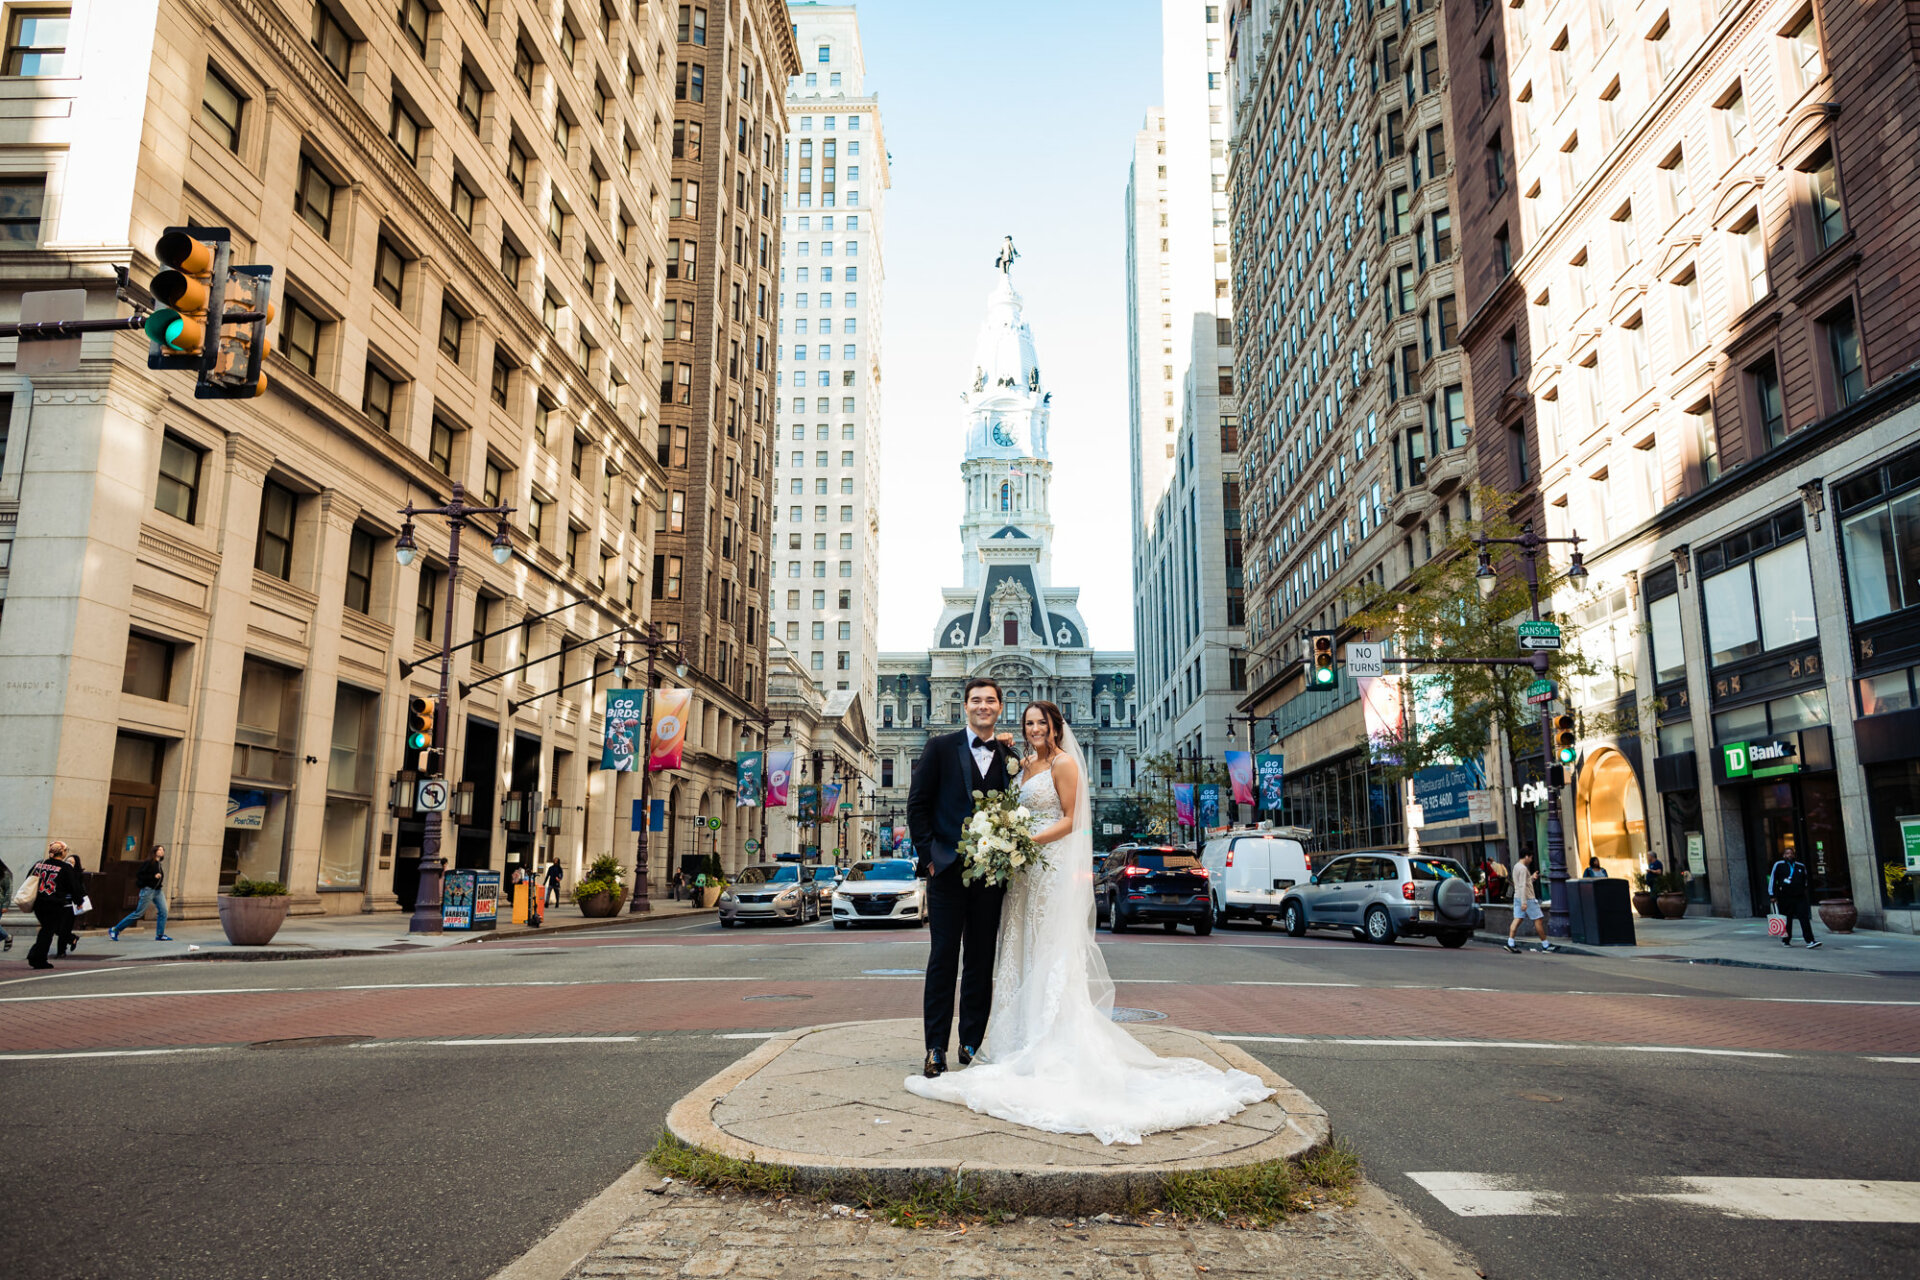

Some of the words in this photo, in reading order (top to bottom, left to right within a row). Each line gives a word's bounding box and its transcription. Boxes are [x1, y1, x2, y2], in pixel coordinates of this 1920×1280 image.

[1520, 626, 1551, 635] SANSOM
[1355, 648, 1372, 658] NO
[1349, 663, 1380, 672] TURNS
[1532, 685, 1546, 696] BROAD
[614, 699, 634, 709] GO
[606, 708, 640, 718] BIRDS
[613, 743, 629, 755] 26
[1726, 748, 1745, 771] TD
[1749, 741, 1784, 762] Bank
[1451, 771, 1466, 785] Office
[1440, 792, 1453, 807] 4600
[477, 885, 497, 900] BARBERA
[476, 900, 491, 913] RAMS
